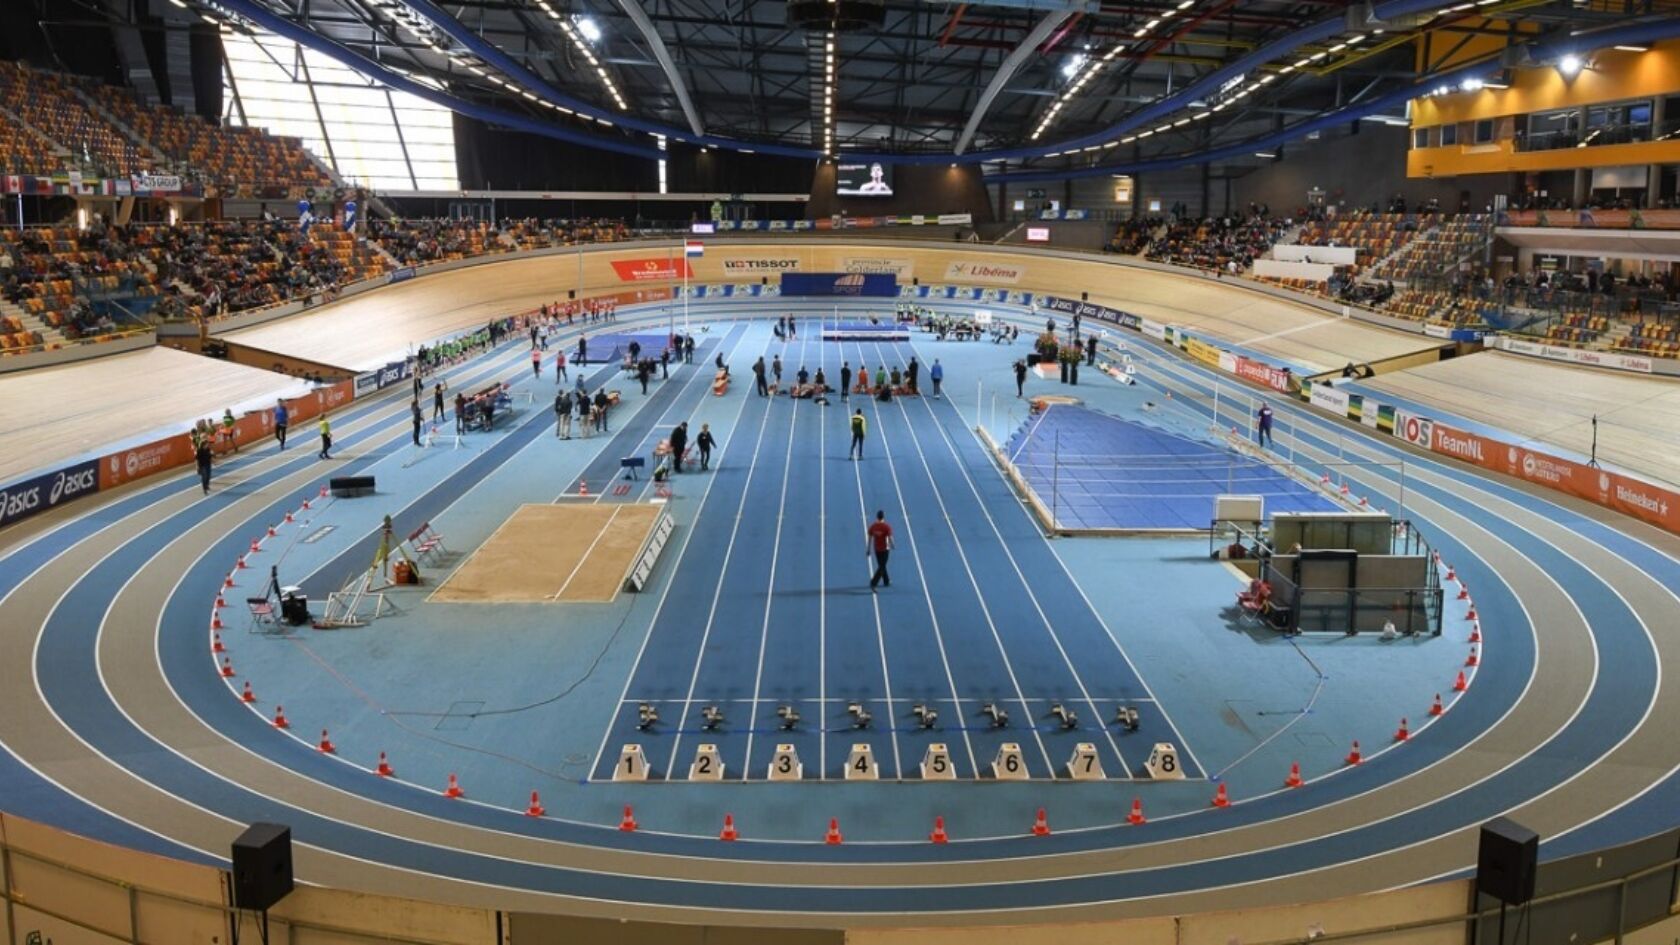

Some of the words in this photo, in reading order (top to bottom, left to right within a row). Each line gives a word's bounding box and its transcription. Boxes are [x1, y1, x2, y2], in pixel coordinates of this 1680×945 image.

[745, 260, 799, 268] TISSOT
[1395, 413, 1430, 446] NOS
[1437, 428, 1484, 460] TeamNL
[1616, 485, 1659, 513] Heineken
[625, 757, 633, 774] 1
[699, 756, 711, 774] 2
[778, 756, 792, 773] 3
[855, 756, 868, 773] 4
[933, 755, 946, 773] 5
[1006, 755, 1019, 772] 6
[1083, 755, 1095, 772] 7
[1162, 754, 1175, 772] 8
